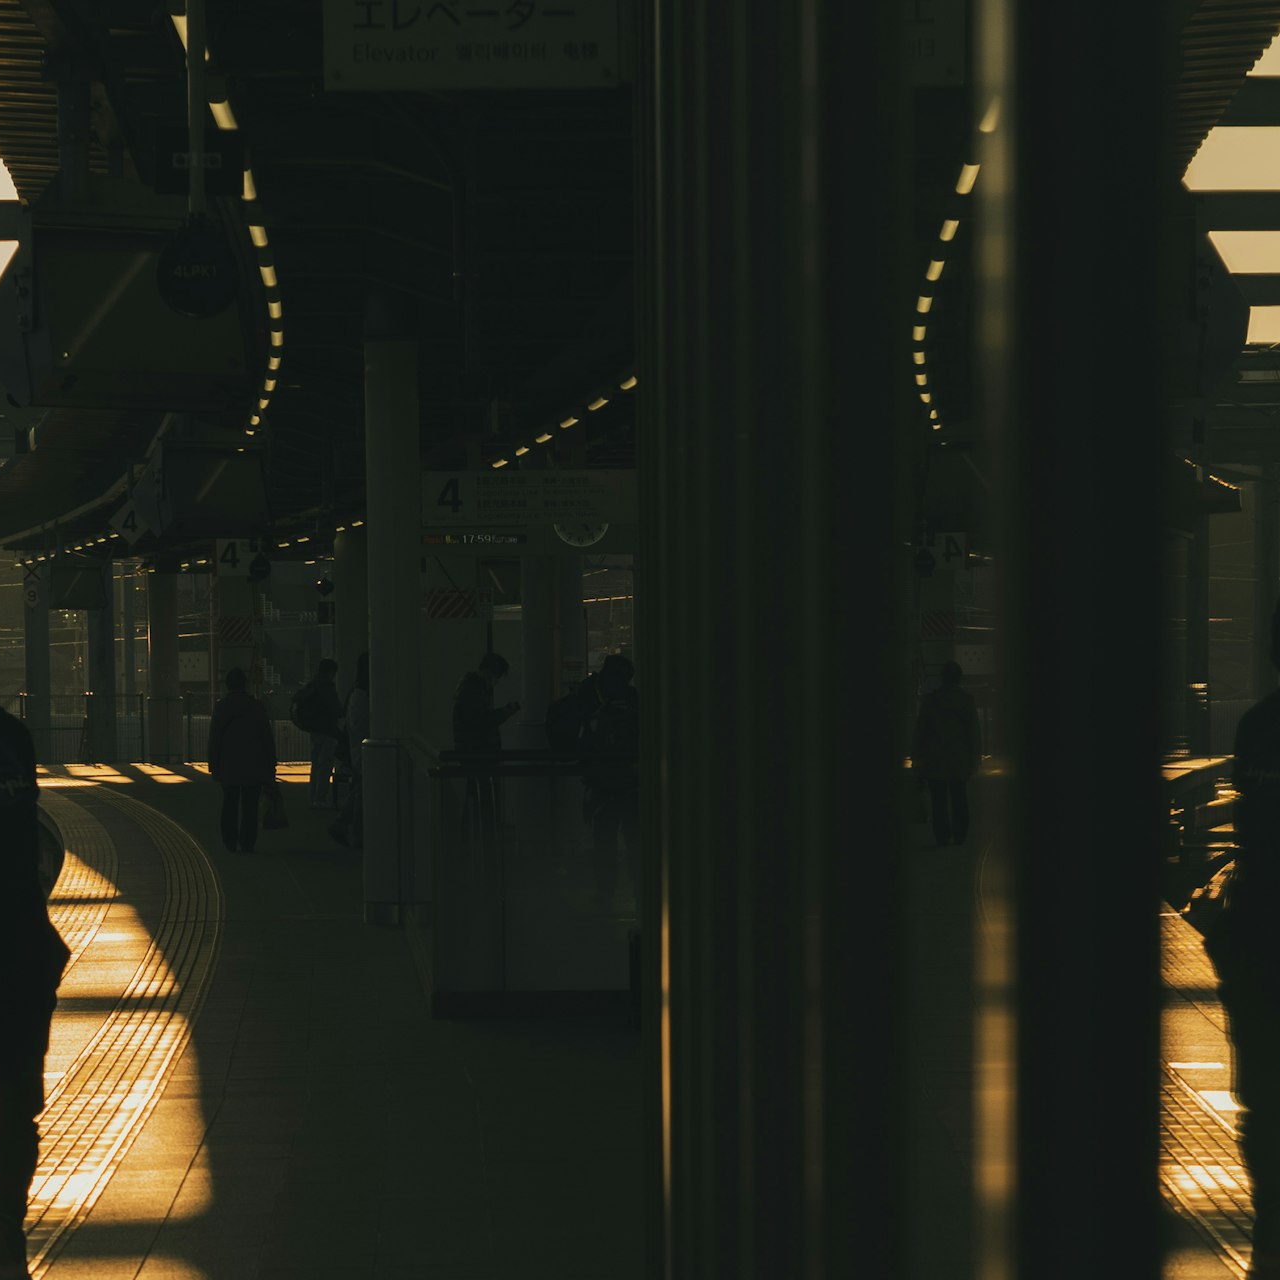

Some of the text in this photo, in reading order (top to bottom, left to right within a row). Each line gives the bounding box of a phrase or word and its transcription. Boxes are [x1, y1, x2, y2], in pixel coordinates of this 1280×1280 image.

[353, 0, 576, 31] エレベーター
[353, 42, 440, 64] Elevator
[437, 477, 463, 513] 4
[122, 509, 138, 533] 4
[220, 541, 240, 569] 4
